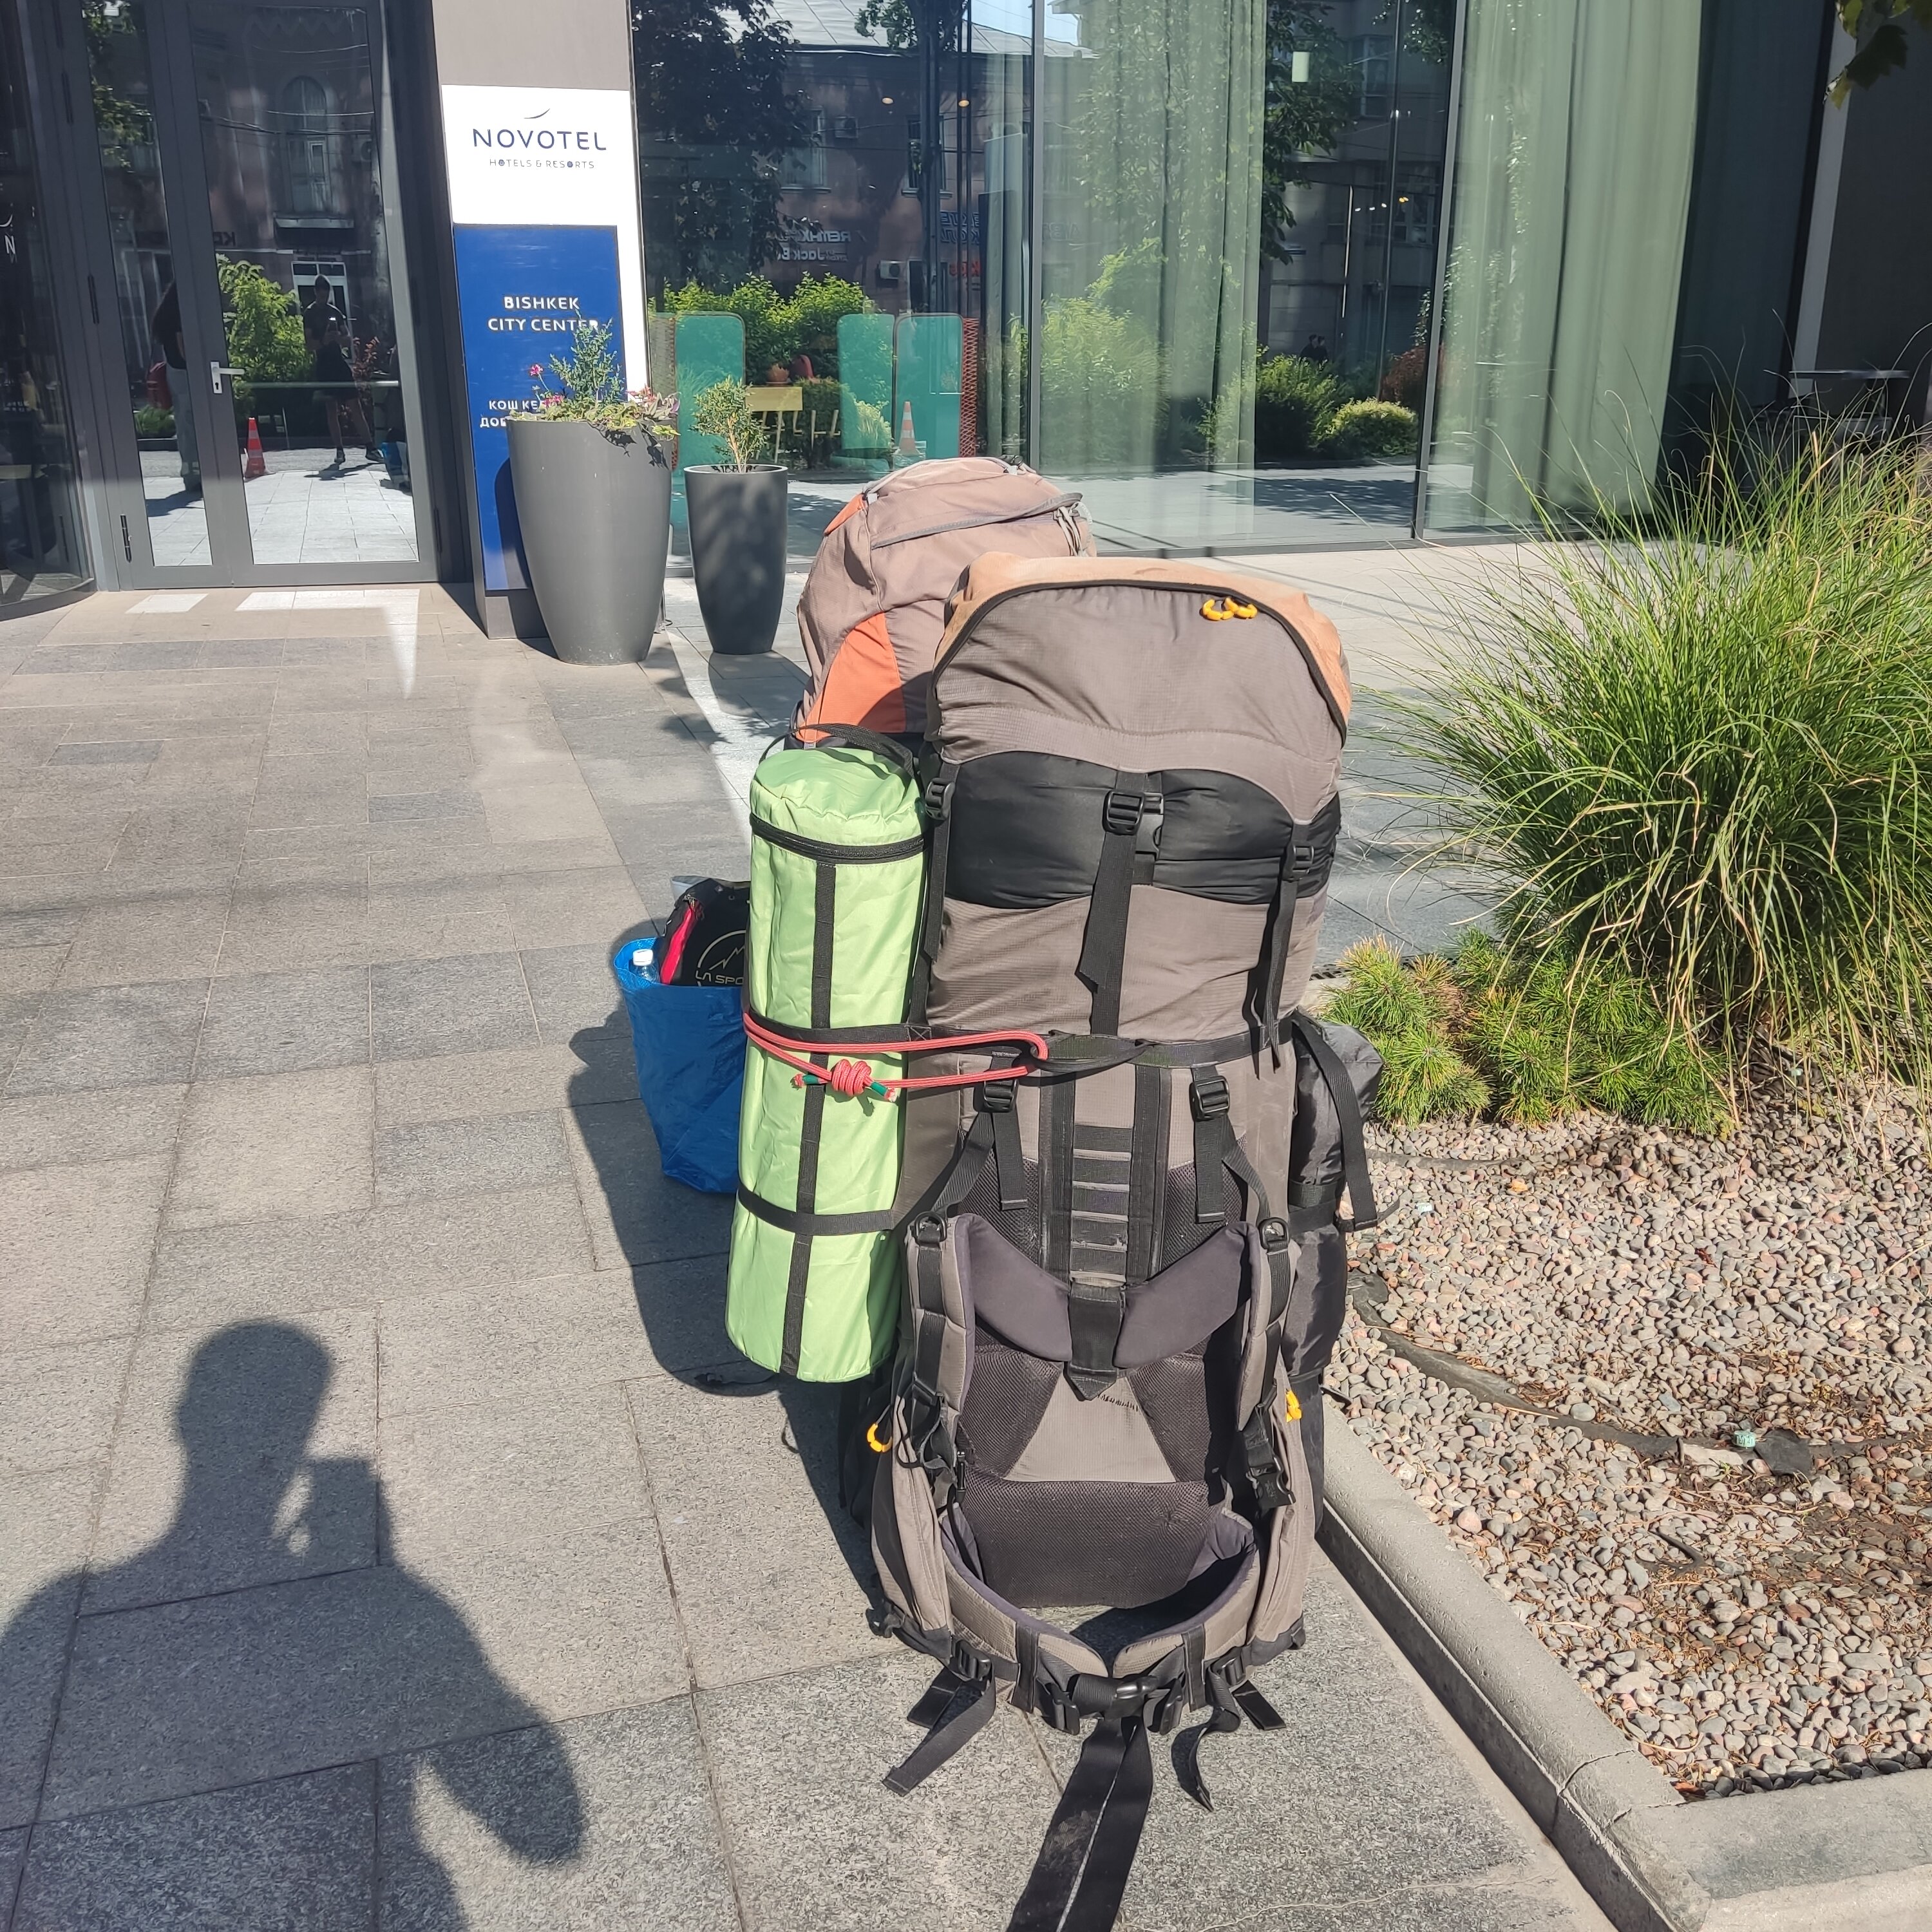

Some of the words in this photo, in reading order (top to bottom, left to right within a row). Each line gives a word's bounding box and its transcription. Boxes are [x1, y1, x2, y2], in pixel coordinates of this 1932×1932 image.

[473, 129, 607, 151] NOVOTEL
[489, 158, 532, 167] HOTELS
[546, 160, 594, 169] RESORTS
[504, 296, 580, 310] BISHKEK
[488, 318, 526, 331] CITY
[531, 319, 598, 332] CENTER
[489, 400, 518, 410] КОШ
[522, 401, 538, 410] КЕ
[696, 970, 712, 982] LA
